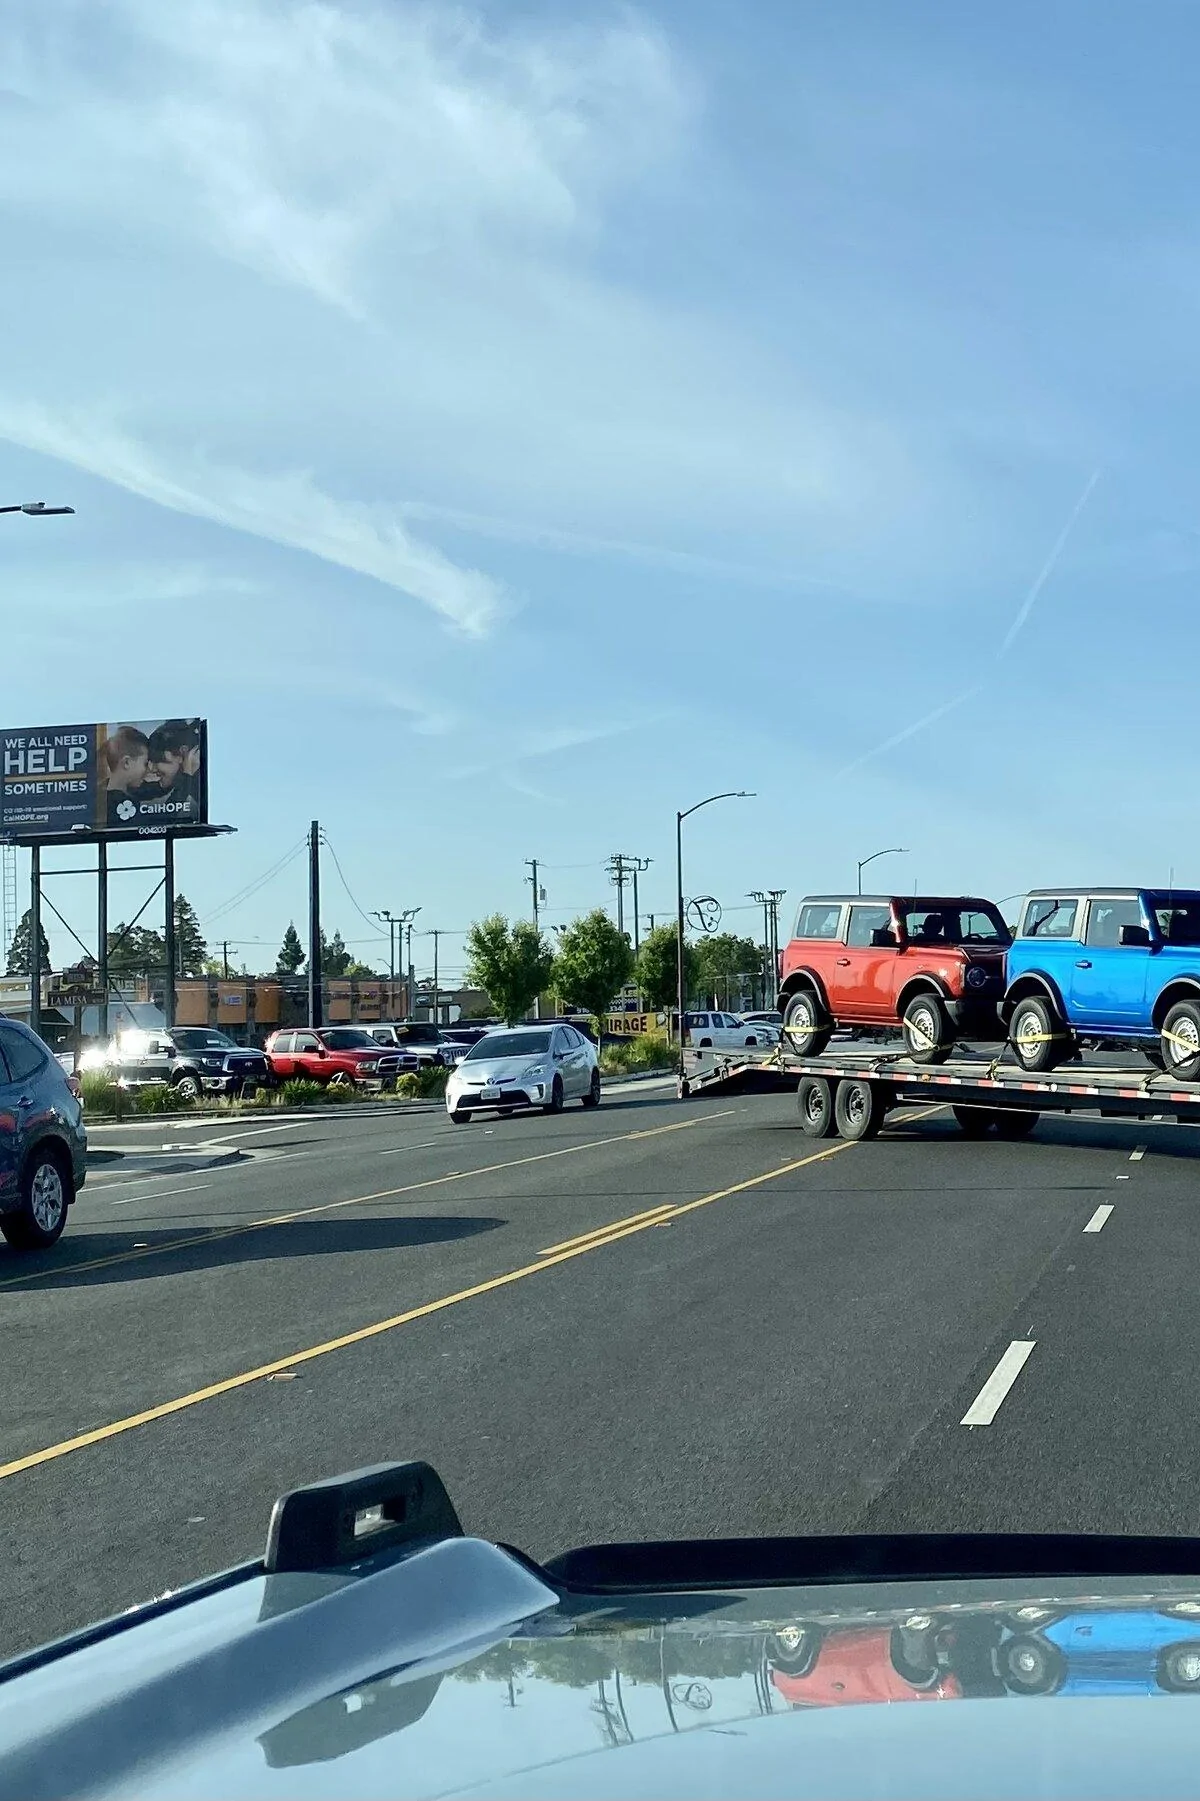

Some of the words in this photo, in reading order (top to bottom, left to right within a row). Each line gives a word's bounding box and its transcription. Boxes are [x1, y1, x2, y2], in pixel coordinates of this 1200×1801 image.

[5, 738, 26, 749] WE
[28, 736, 50, 748] ALL
[54, 734, 88, 747] NEED
[4, 747, 88, 775] HELP
[4, 780, 87, 796] SOMETIMES
[139, 801, 191, 814] CalHOPE
[3, 814, 49, 822] CalHOPE.org
[64, 995, 87, 1004] MESA
